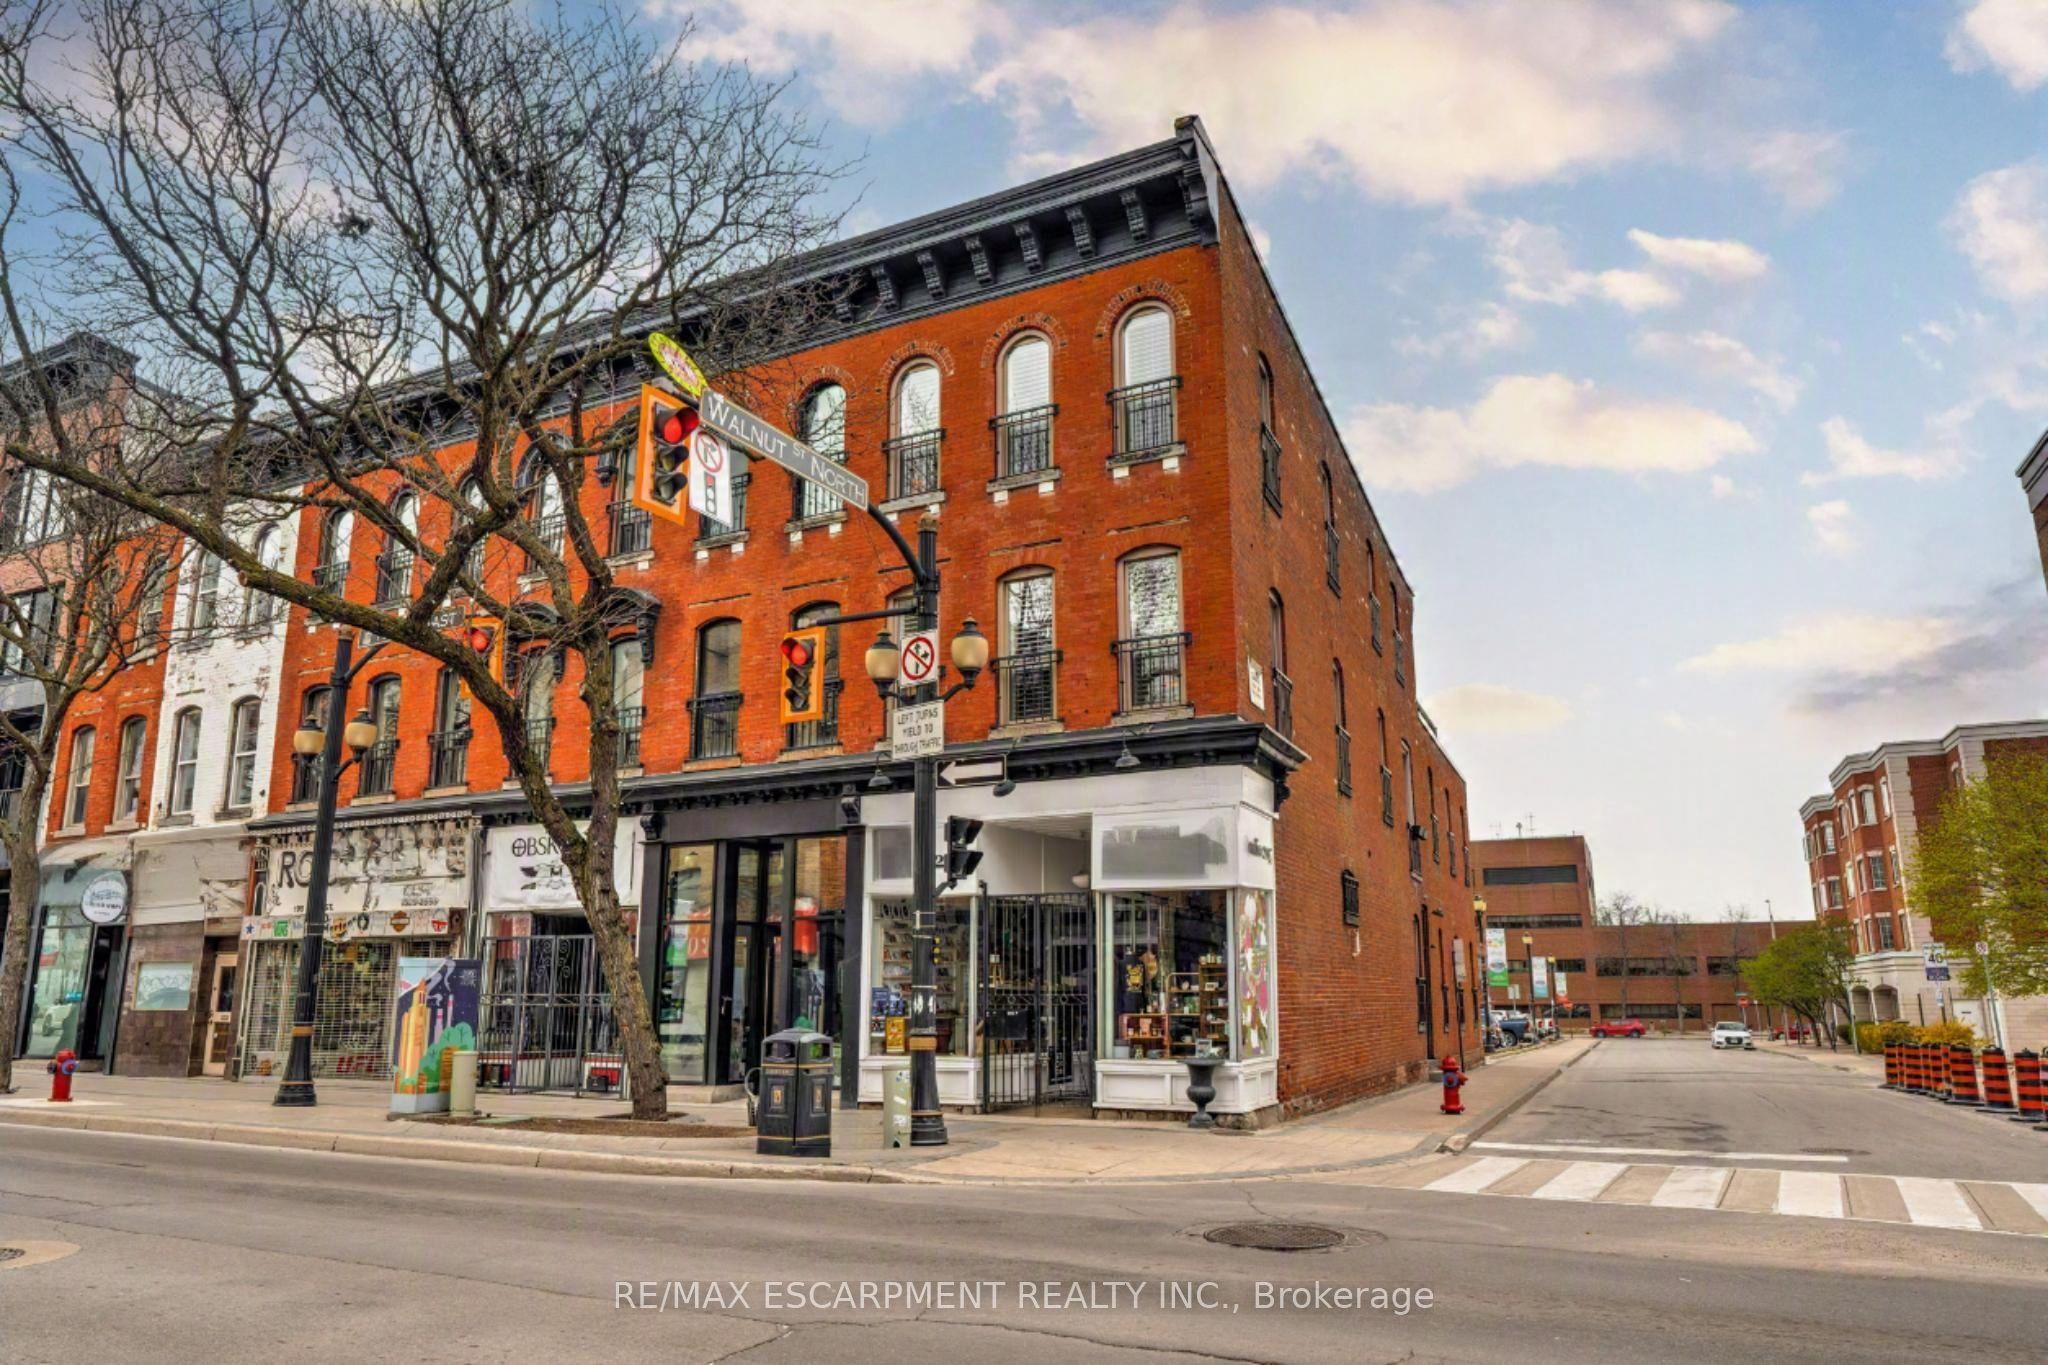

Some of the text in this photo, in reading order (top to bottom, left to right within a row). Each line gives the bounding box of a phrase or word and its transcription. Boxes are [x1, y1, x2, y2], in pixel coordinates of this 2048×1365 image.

[708, 395, 787, 459] WALNUT
[811, 455, 865, 499] NORTH
[897, 706, 938, 725] LEFT TURNS
[902, 723, 934, 738] YIELD TO
[894, 736, 942, 755] THROUGH TRAFFIC
